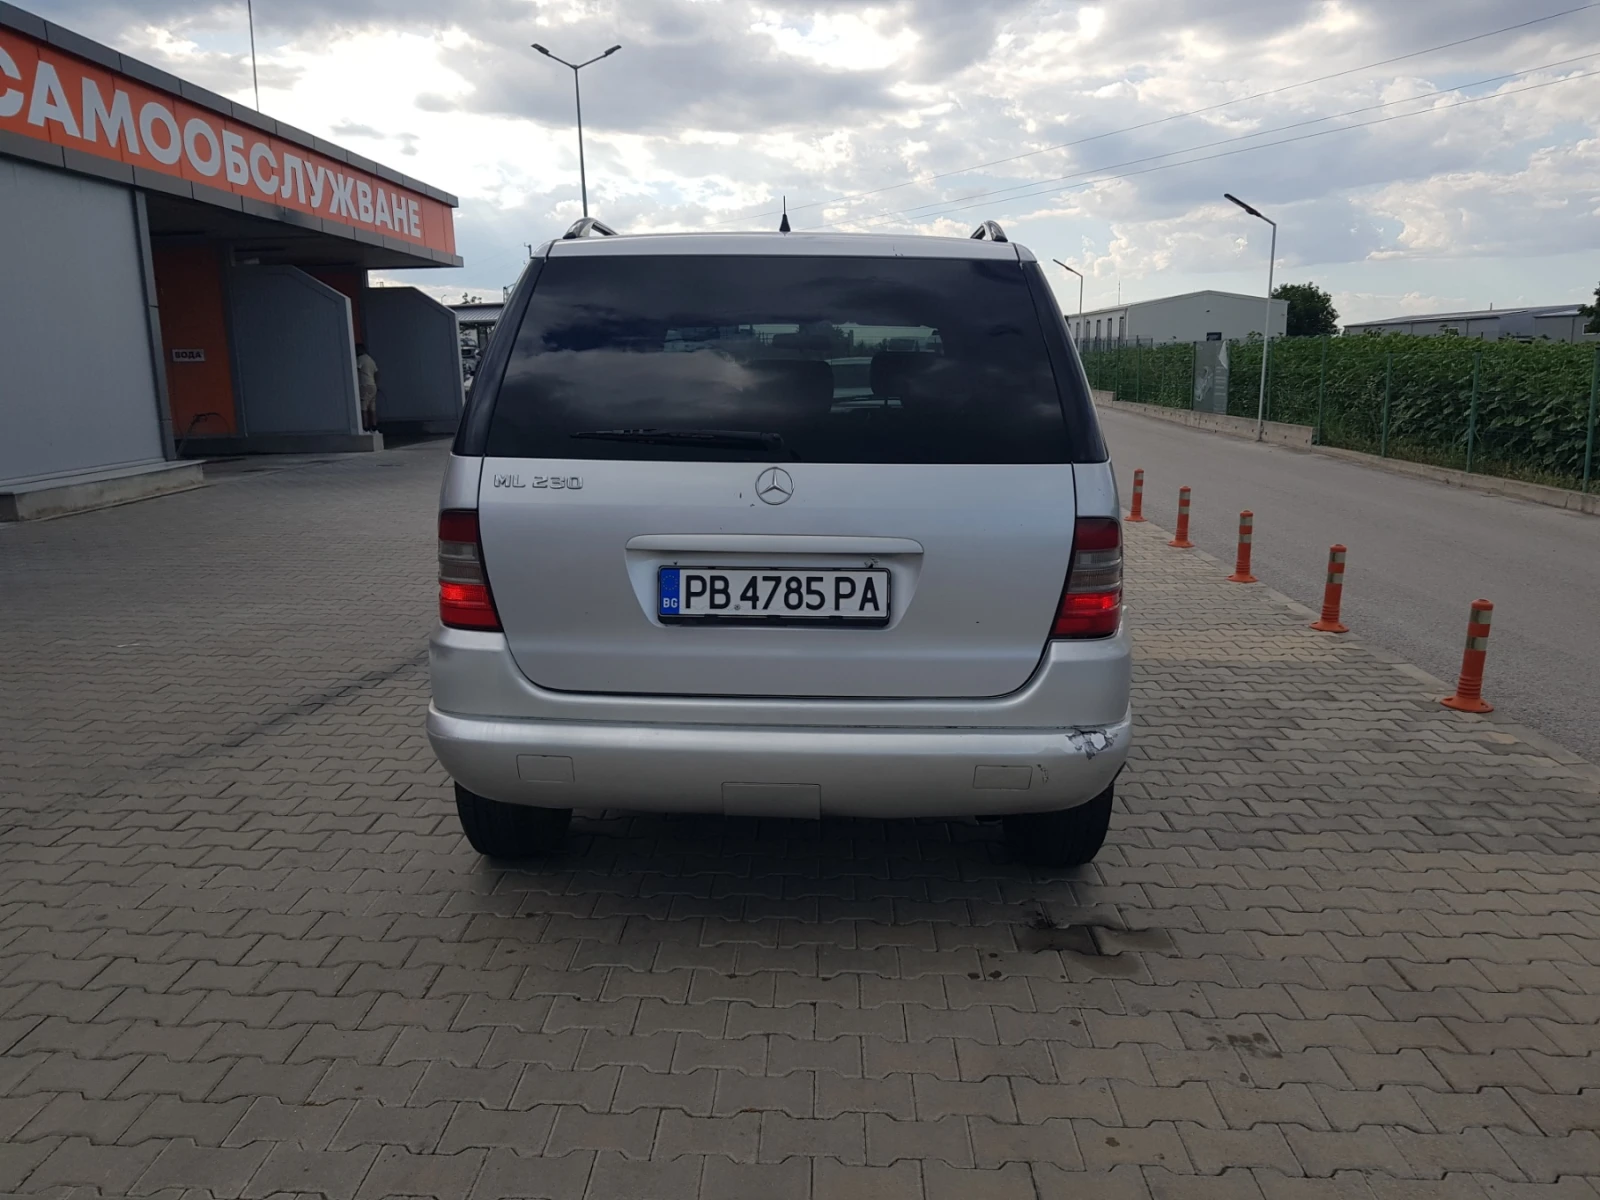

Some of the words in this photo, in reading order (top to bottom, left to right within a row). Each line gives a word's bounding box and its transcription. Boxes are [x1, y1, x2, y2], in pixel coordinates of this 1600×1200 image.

[0, 46, 421, 238] САМООБСЛУЖВАНЕ
[174, 351, 202, 359] ВОДА
[494, 474, 526, 488] ML
[532, 475, 584, 490] 230
[739, 576, 826, 610] 4785
[663, 597, 678, 608] BG
